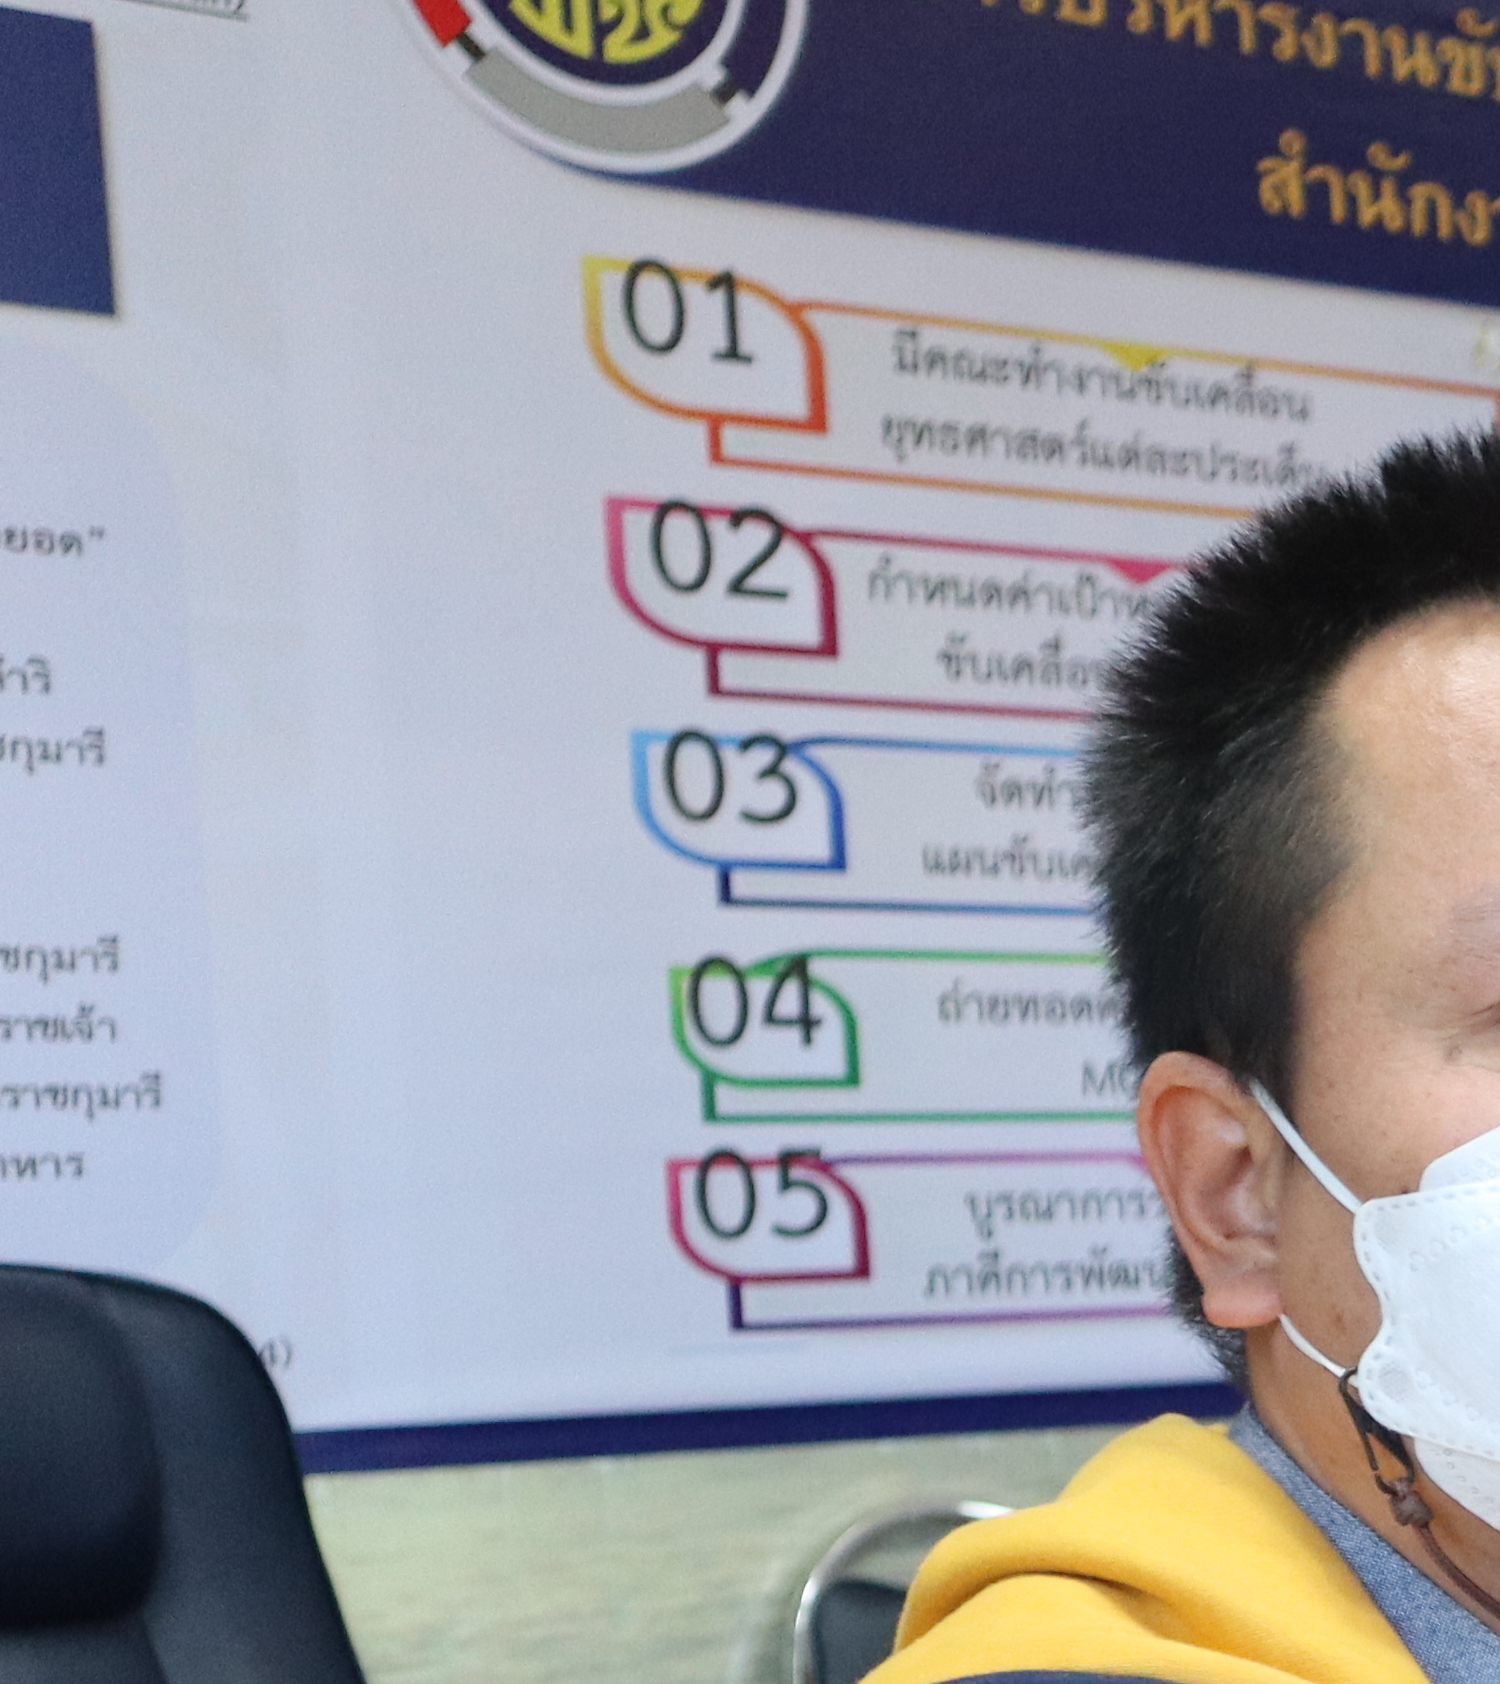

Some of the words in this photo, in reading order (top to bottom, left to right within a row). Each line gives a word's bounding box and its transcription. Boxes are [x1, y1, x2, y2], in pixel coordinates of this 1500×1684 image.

[622, 258, 755, 366] 01
[891, 327, 1312, 422] มีคณะทำงานขับเคลื่อน
[649, 500, 790, 601] 02
[868, 551, 1150, 619] กำหนดค่าเป้าห
[664, 728, 798, 825] 03
[921, 832, 1096, 880] แผนขับเค
[688, 954, 823, 1048] 04
[694, 1149, 829, 1241] 05
[923, 1246, 1174, 1297] ภาคีการพัฒน
